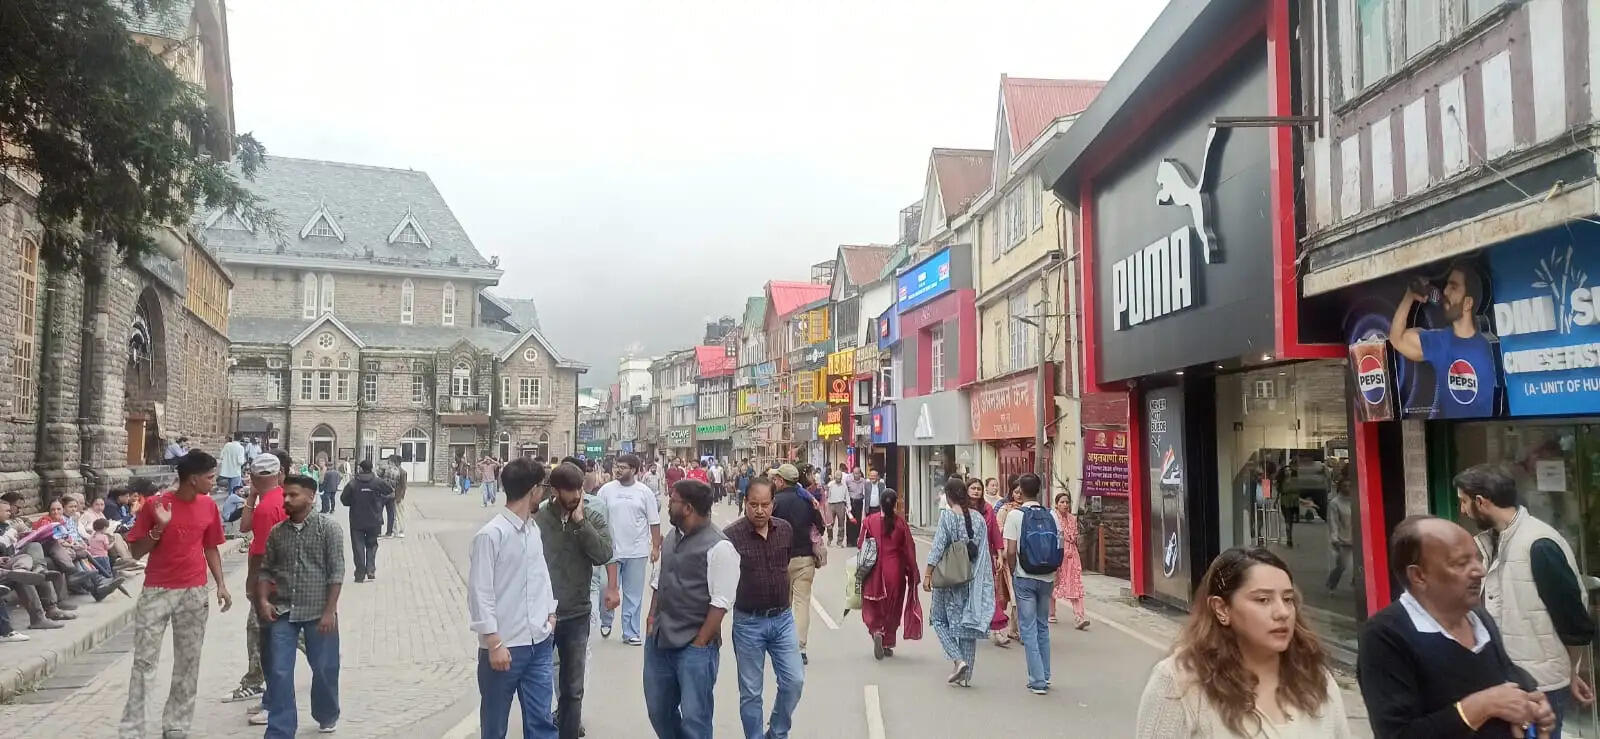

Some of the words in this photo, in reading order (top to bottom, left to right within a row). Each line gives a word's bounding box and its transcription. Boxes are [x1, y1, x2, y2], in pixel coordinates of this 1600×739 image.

[1112, 225, 1192, 331] PUMA
[1494, 295, 1556, 337] DIM
[1359, 373, 1384, 386] PEPSI
[1449, 375, 1476, 388] PEPSI
[1566, 379, 1581, 393] OF
[1582, 378, 1600, 392] HU
[1150, 398, 1166, 411] NEVER
[1151, 410, 1160, 421] NOT
[1087, 451, 1117, 465] अमृतवाणी
